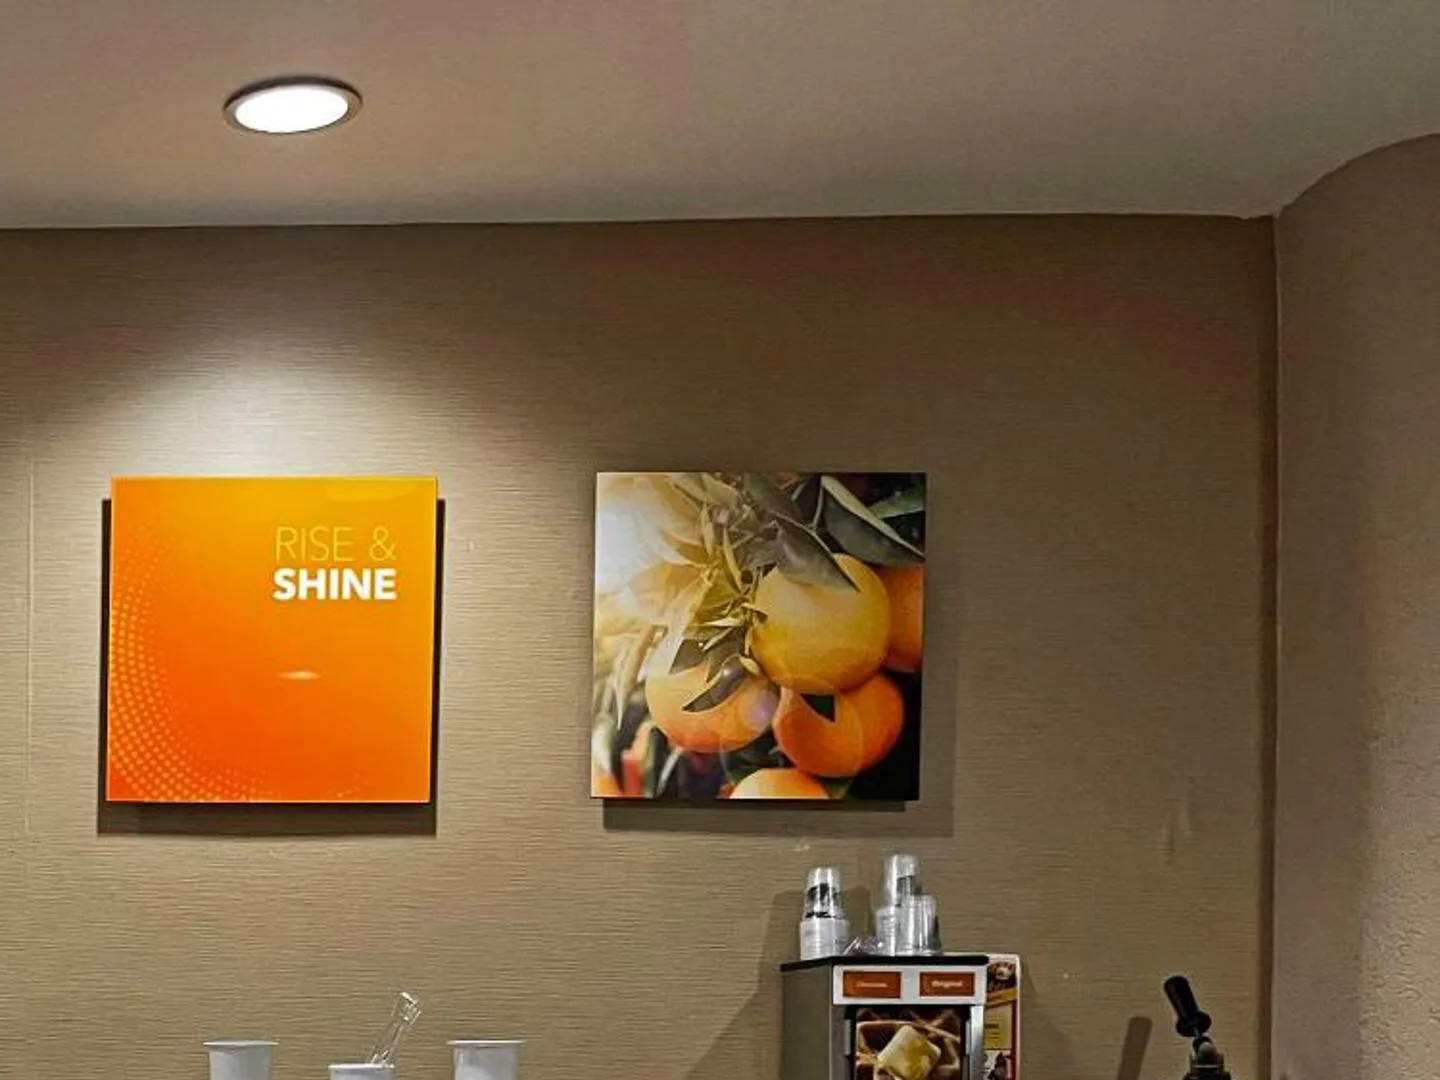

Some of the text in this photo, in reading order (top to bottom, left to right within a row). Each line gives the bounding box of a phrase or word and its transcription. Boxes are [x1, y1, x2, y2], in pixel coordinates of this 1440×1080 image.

[275, 525, 397, 562] RISE &
[272, 567, 398, 601] SHINE
